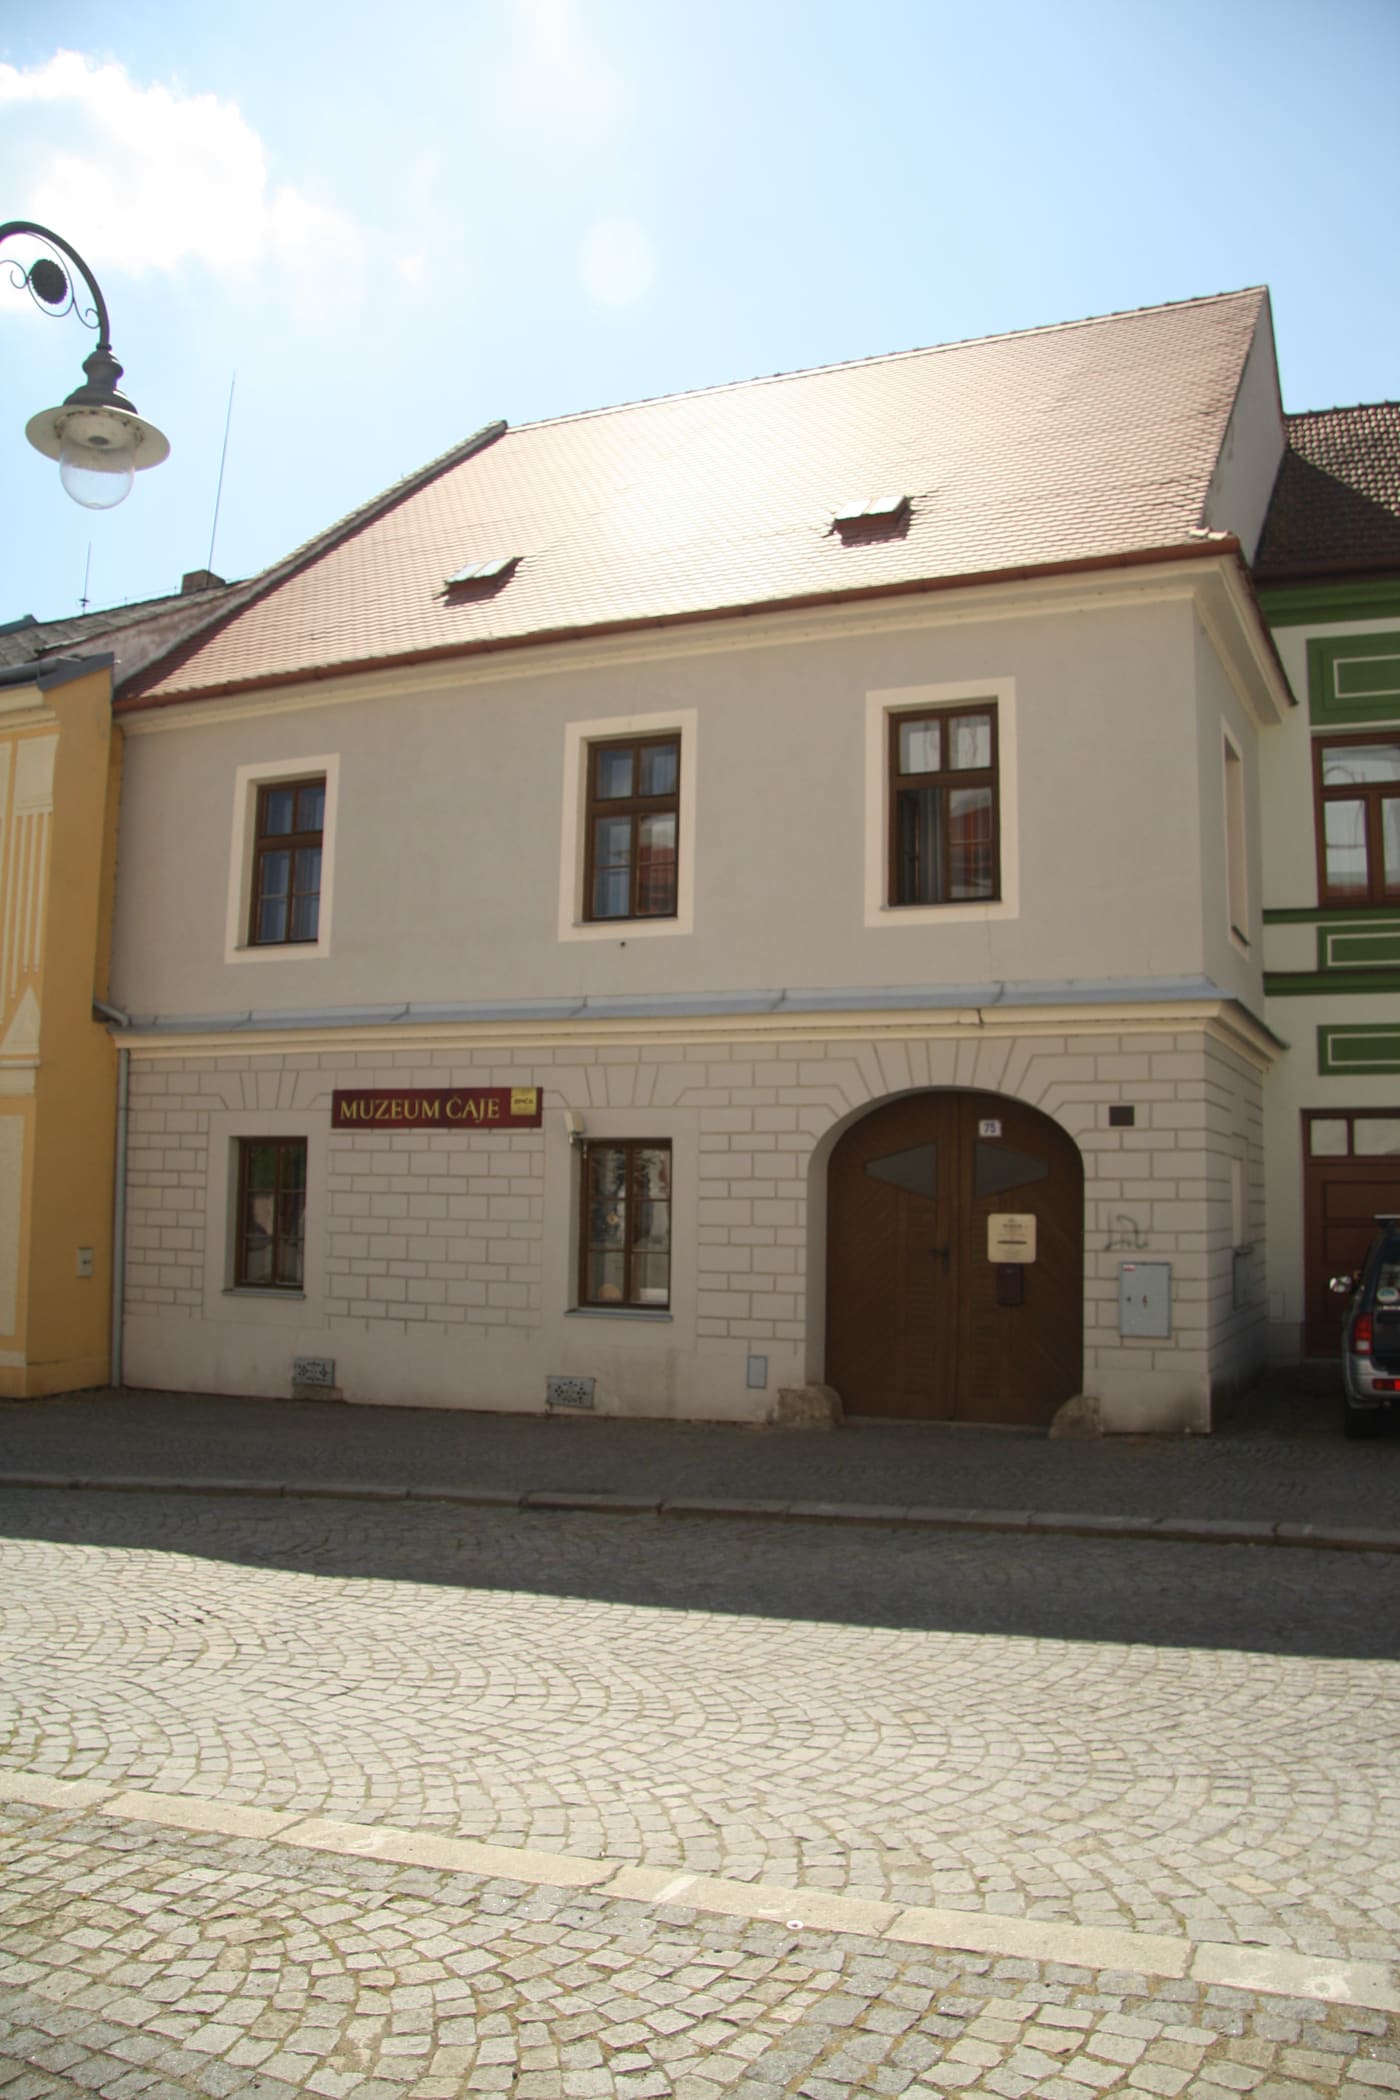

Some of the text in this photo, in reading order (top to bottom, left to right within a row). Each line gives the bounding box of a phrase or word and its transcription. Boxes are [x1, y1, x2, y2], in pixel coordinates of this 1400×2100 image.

[340, 1096, 500, 1123] MUZEUM ČAJE
[983, 1122, 997, 1134] 75
